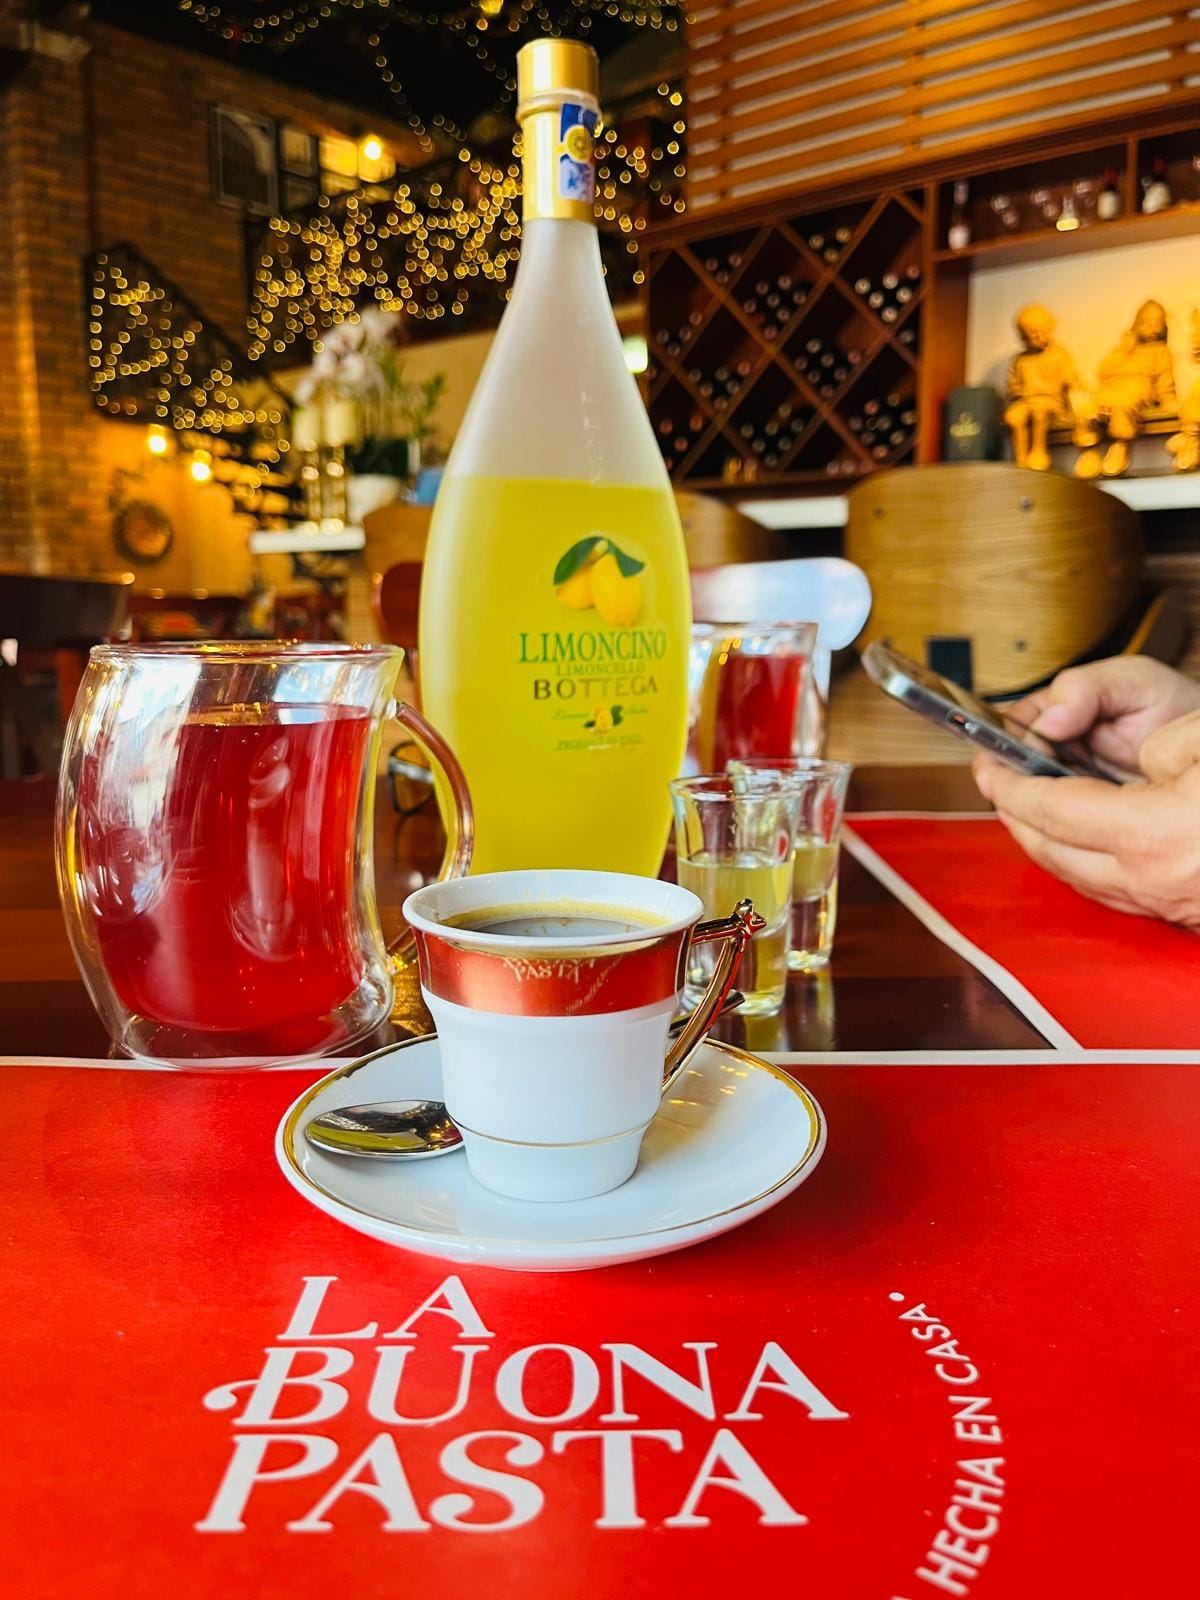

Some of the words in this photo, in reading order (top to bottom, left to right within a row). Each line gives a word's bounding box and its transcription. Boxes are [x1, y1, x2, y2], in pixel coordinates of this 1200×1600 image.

[519, 631, 667, 662] LIMONCINO
[533, 675, 658, 700] BOTTEGA
[276, 1274, 496, 1341] LA
[898, 1303, 980, 1385] CASA
[203, 1341, 849, 1428] BUONA
[948, 1395, 1003, 1443] EN
[195, 1428, 808, 1533] PASTA
[916, 1456, 1005, 1596] HECHA
